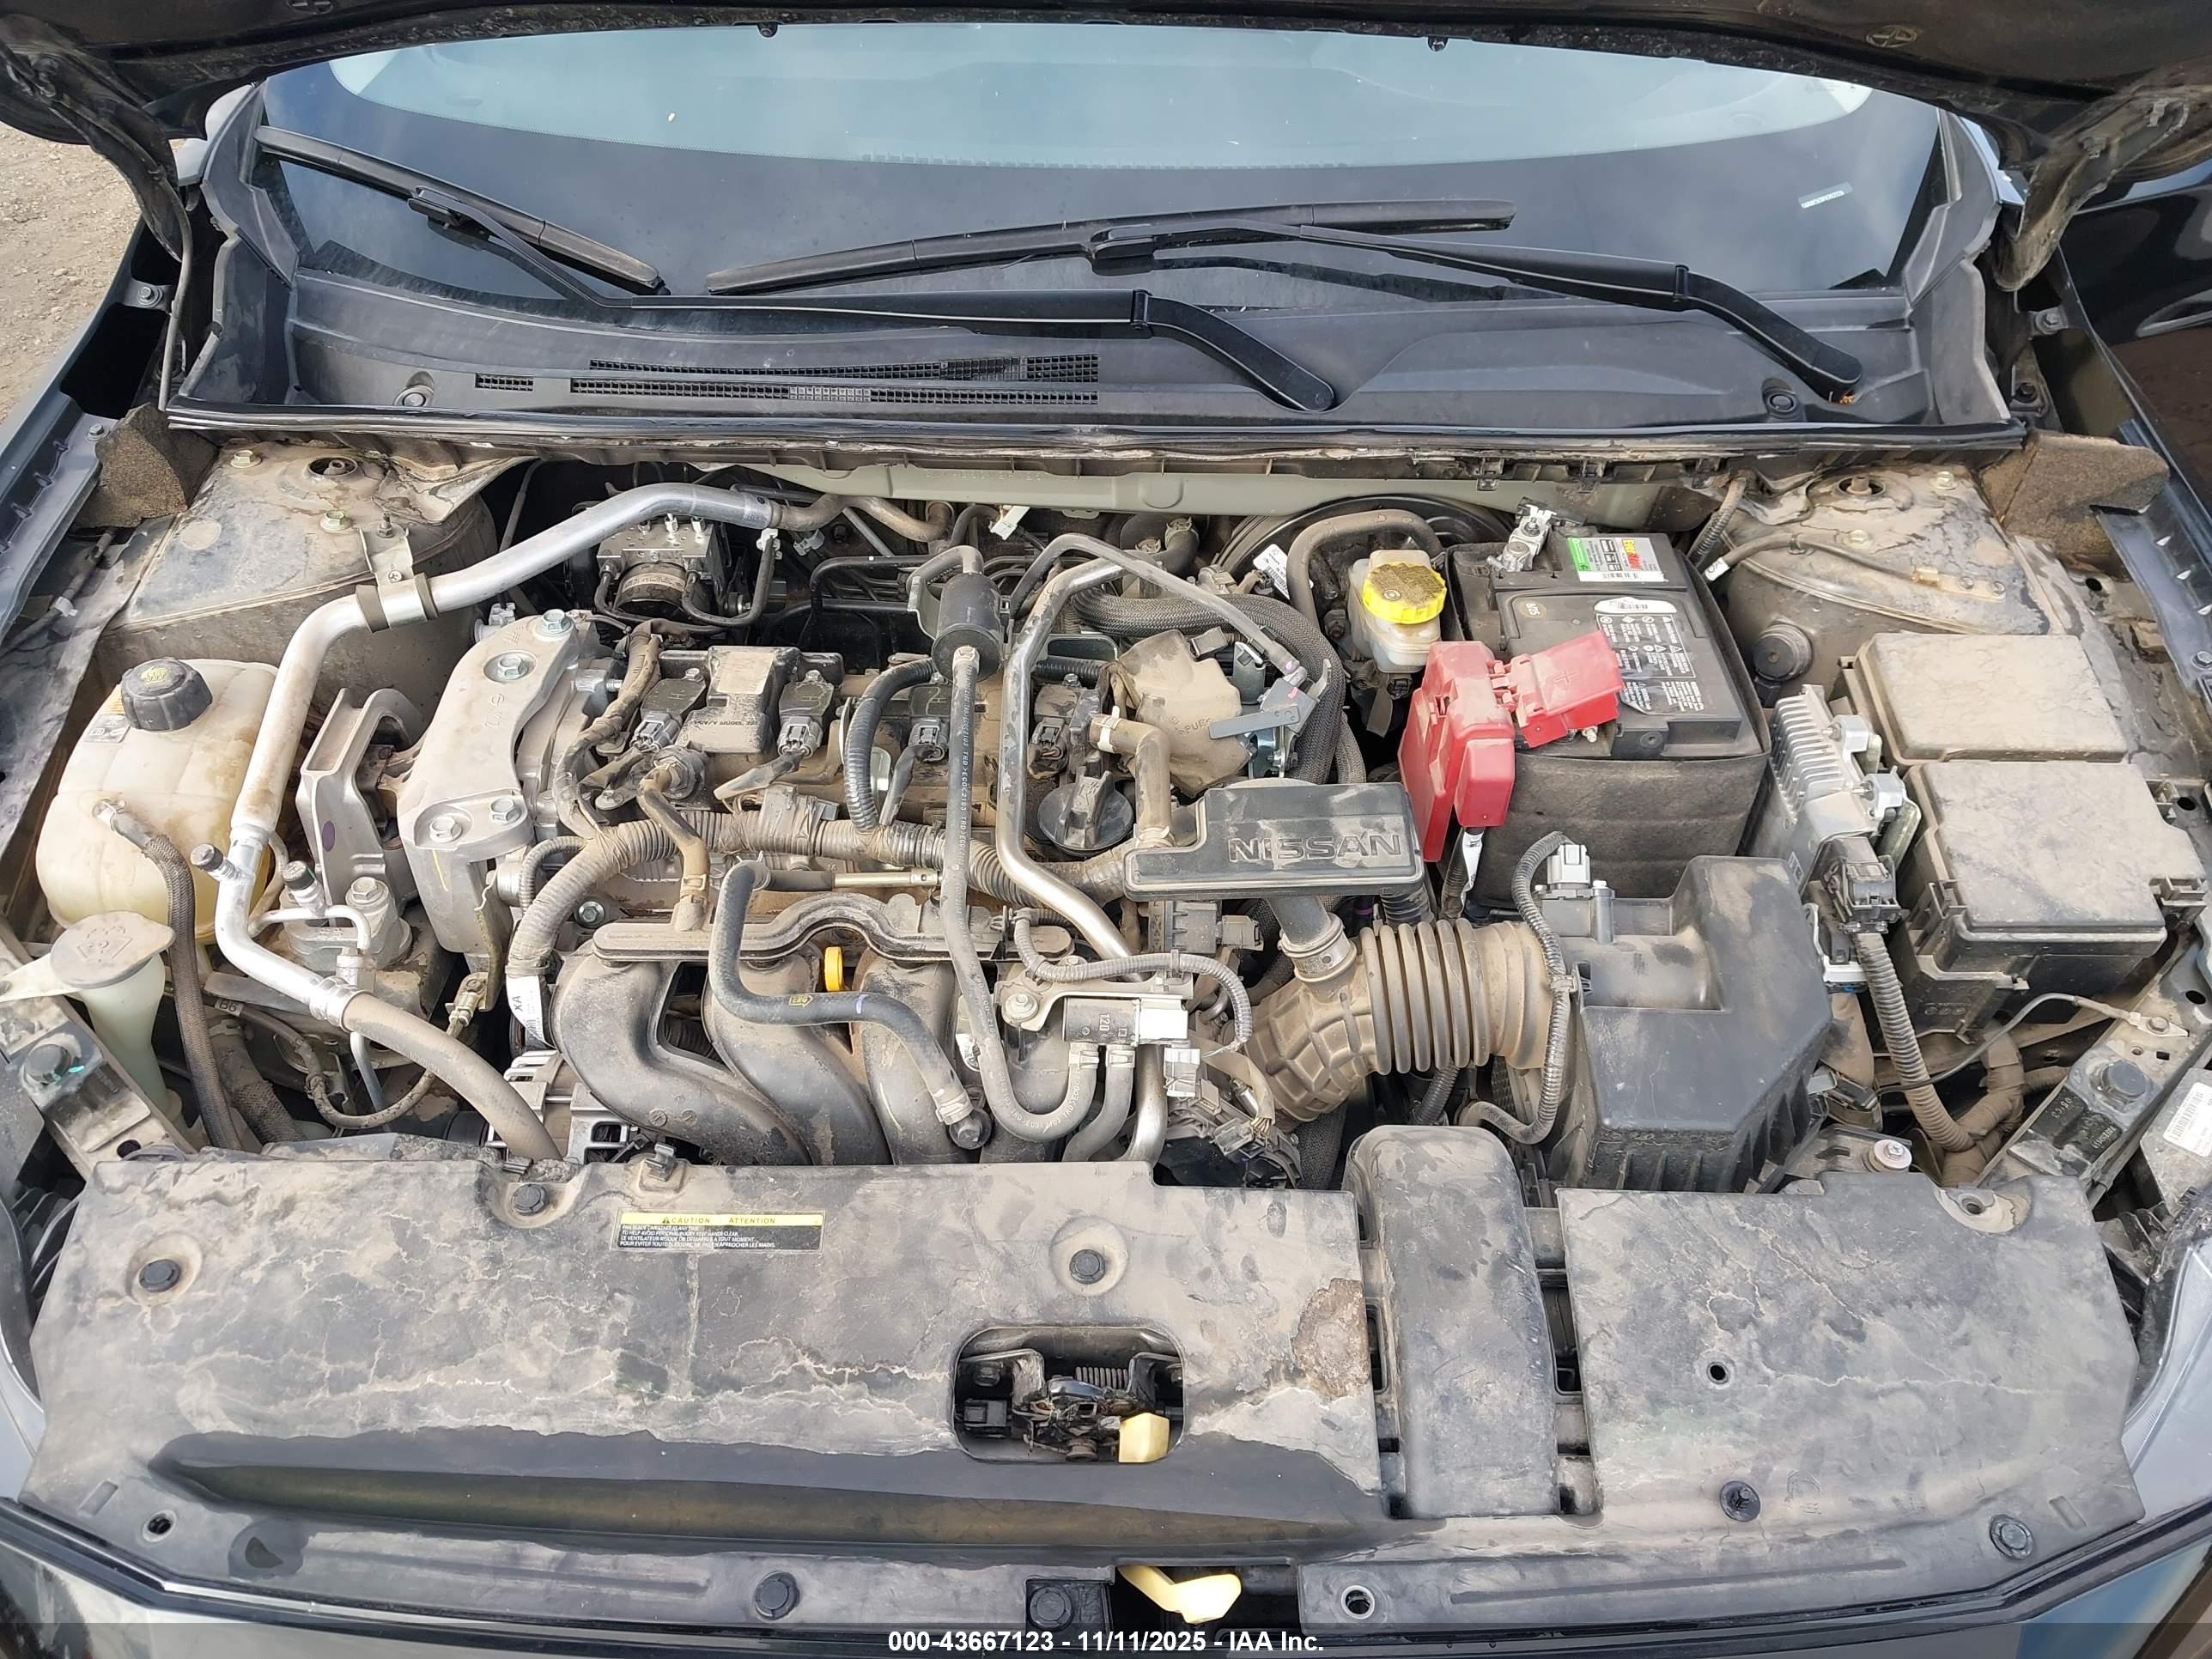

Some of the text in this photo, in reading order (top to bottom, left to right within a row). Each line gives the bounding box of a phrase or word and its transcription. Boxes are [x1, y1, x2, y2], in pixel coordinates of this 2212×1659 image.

[1228, 835, 1401, 863] NISSAN
[512, 994, 523, 1012] XA
[1099, 1012, 1110, 1031] 120
